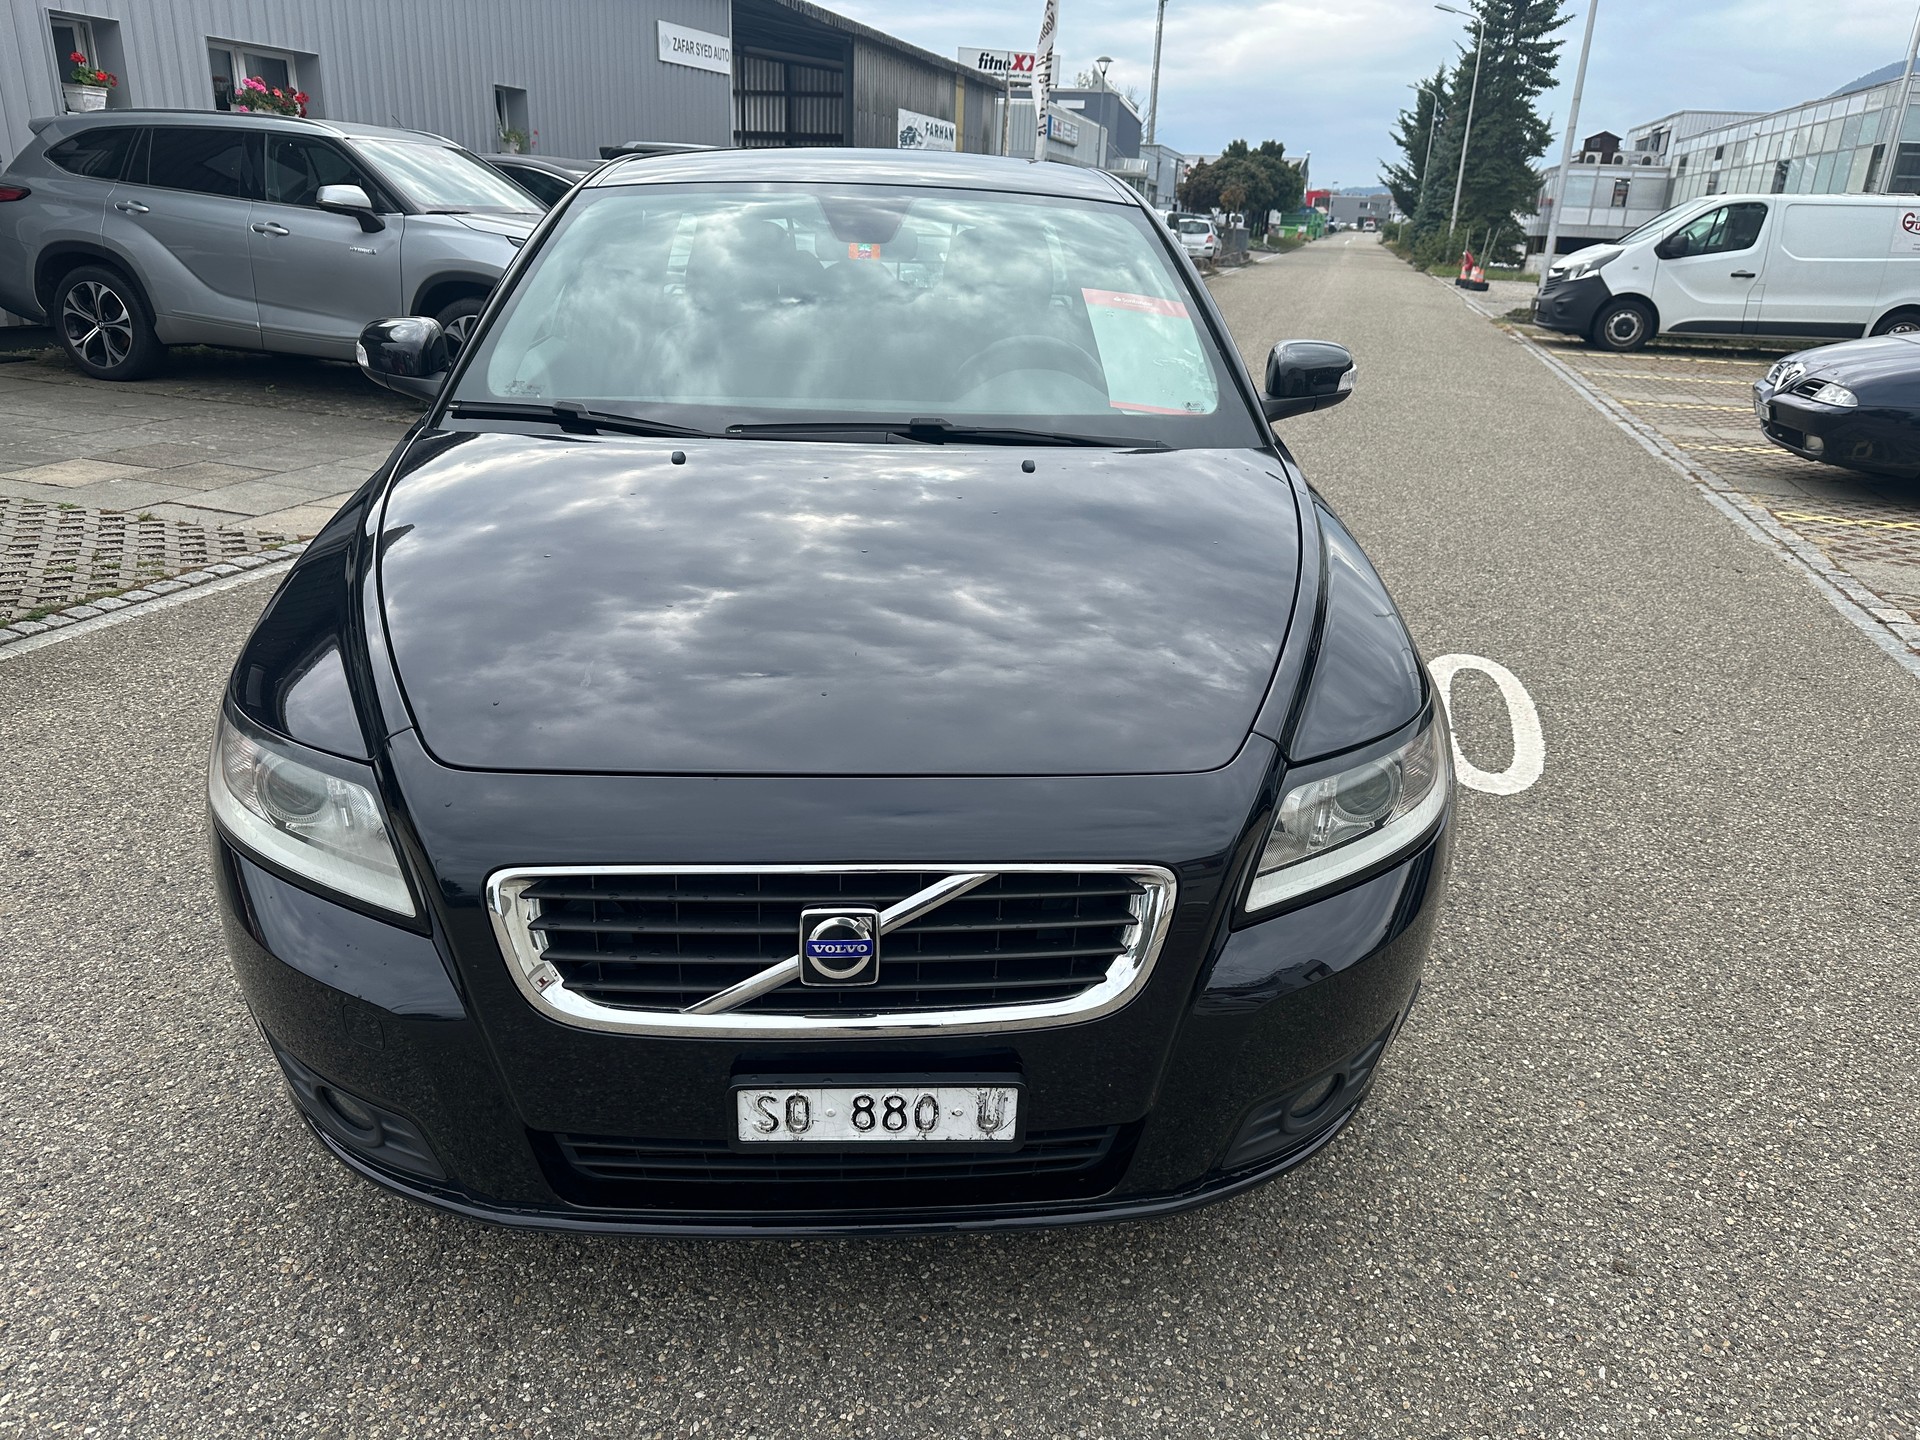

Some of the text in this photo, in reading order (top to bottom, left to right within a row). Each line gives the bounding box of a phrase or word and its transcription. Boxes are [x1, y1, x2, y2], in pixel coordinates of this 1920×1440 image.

[672, 37, 730, 62] ZAFAR SYED AUTO
[925, 121, 954, 142] FARHAN
[811, 944, 868, 953] VOLVO
[851, 1091, 940, 1134] 880
[975, 1088, 1004, 1134] U
